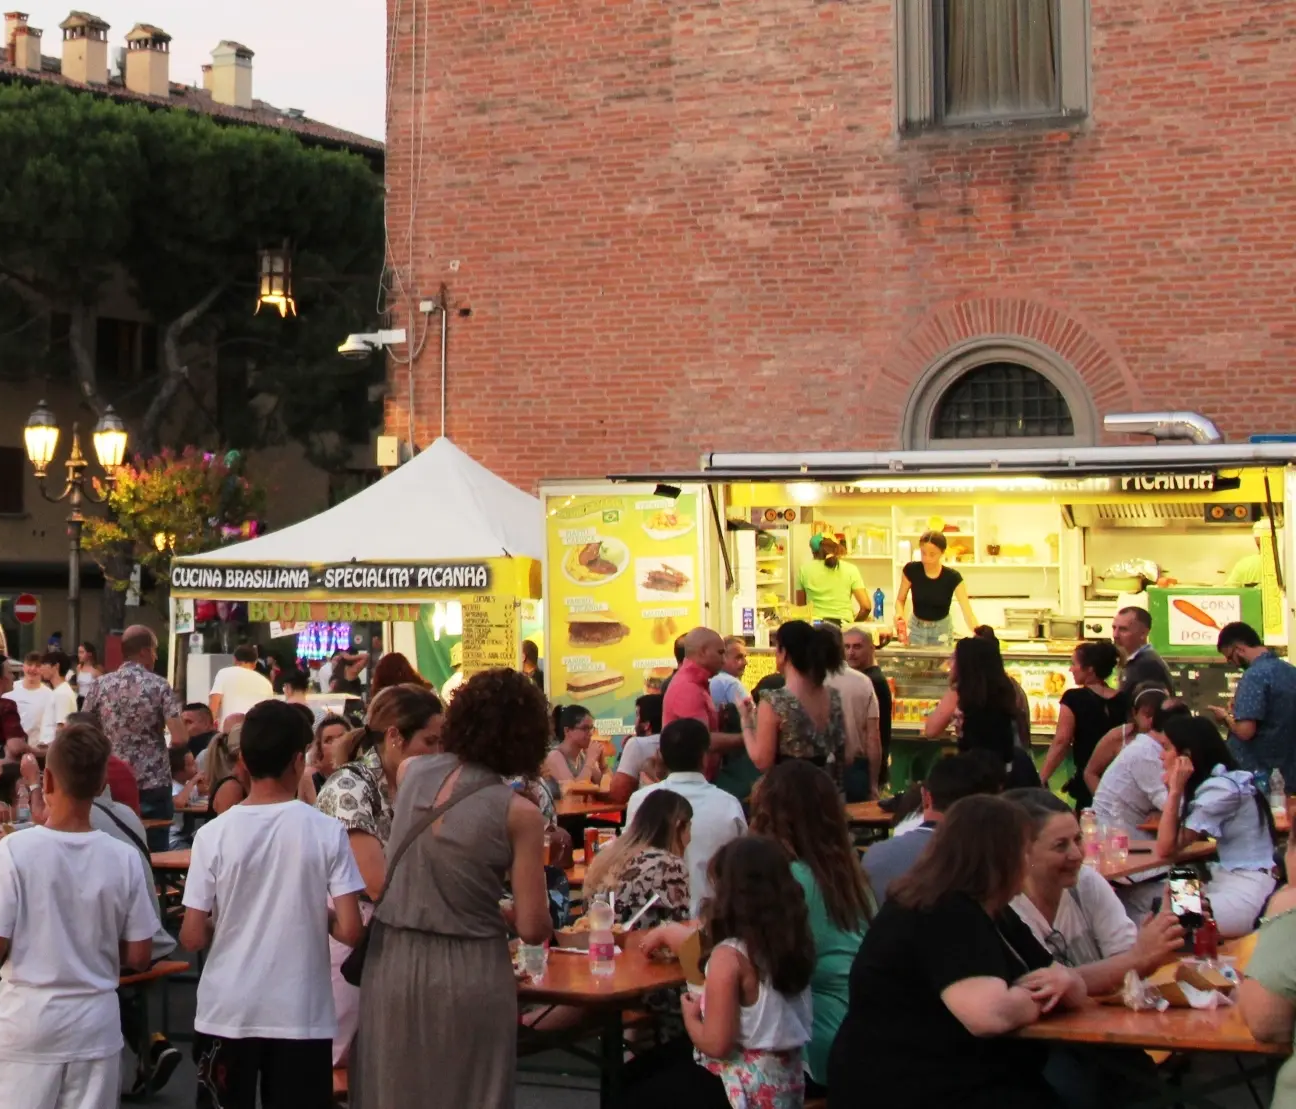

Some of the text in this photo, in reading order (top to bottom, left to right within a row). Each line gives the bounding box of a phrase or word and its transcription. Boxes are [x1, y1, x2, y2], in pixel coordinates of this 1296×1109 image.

[172, 567, 223, 587] CUCINA
[225, 569, 309, 589] BRASILIANA
[324, 567, 414, 588] SPECIALITA'
[418, 566, 488, 588] PICANHA
[1200, 599, 1235, 610] CORN
[1181, 630, 1212, 641] DOG
